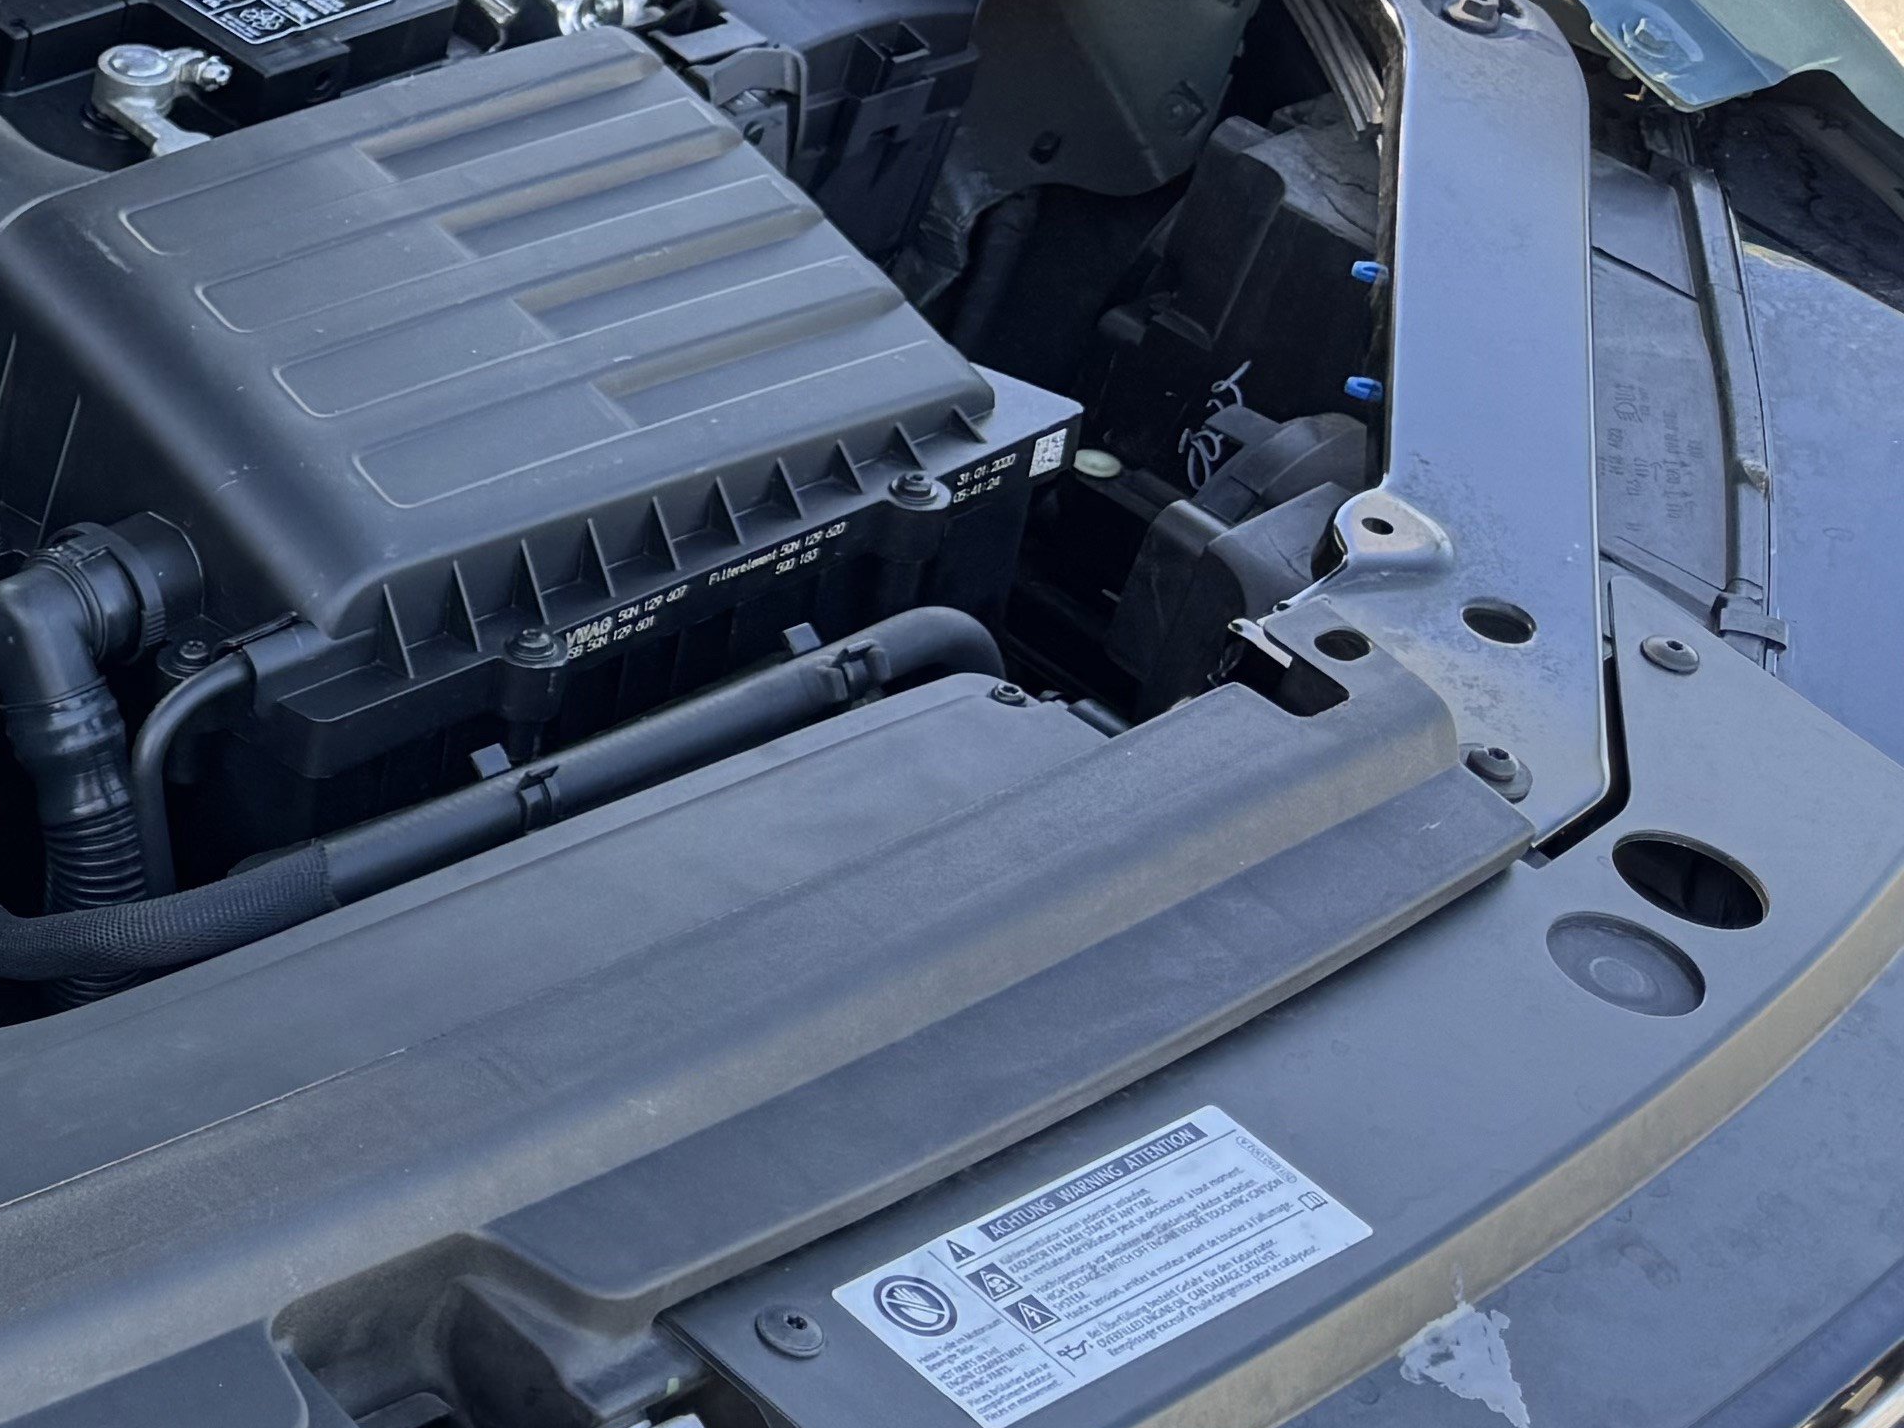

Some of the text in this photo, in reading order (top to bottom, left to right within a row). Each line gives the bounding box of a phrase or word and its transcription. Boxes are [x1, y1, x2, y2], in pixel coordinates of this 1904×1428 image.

[804, 530, 823, 546] 129
[643, 594, 664, 612] 129
[612, 623, 632, 641] 129
[988, 1197, 1056, 1236] ACHTUNG
[1056, 1164, 1123, 1202] WARNING
[1124, 1129, 1195, 1170] ATTENTION
